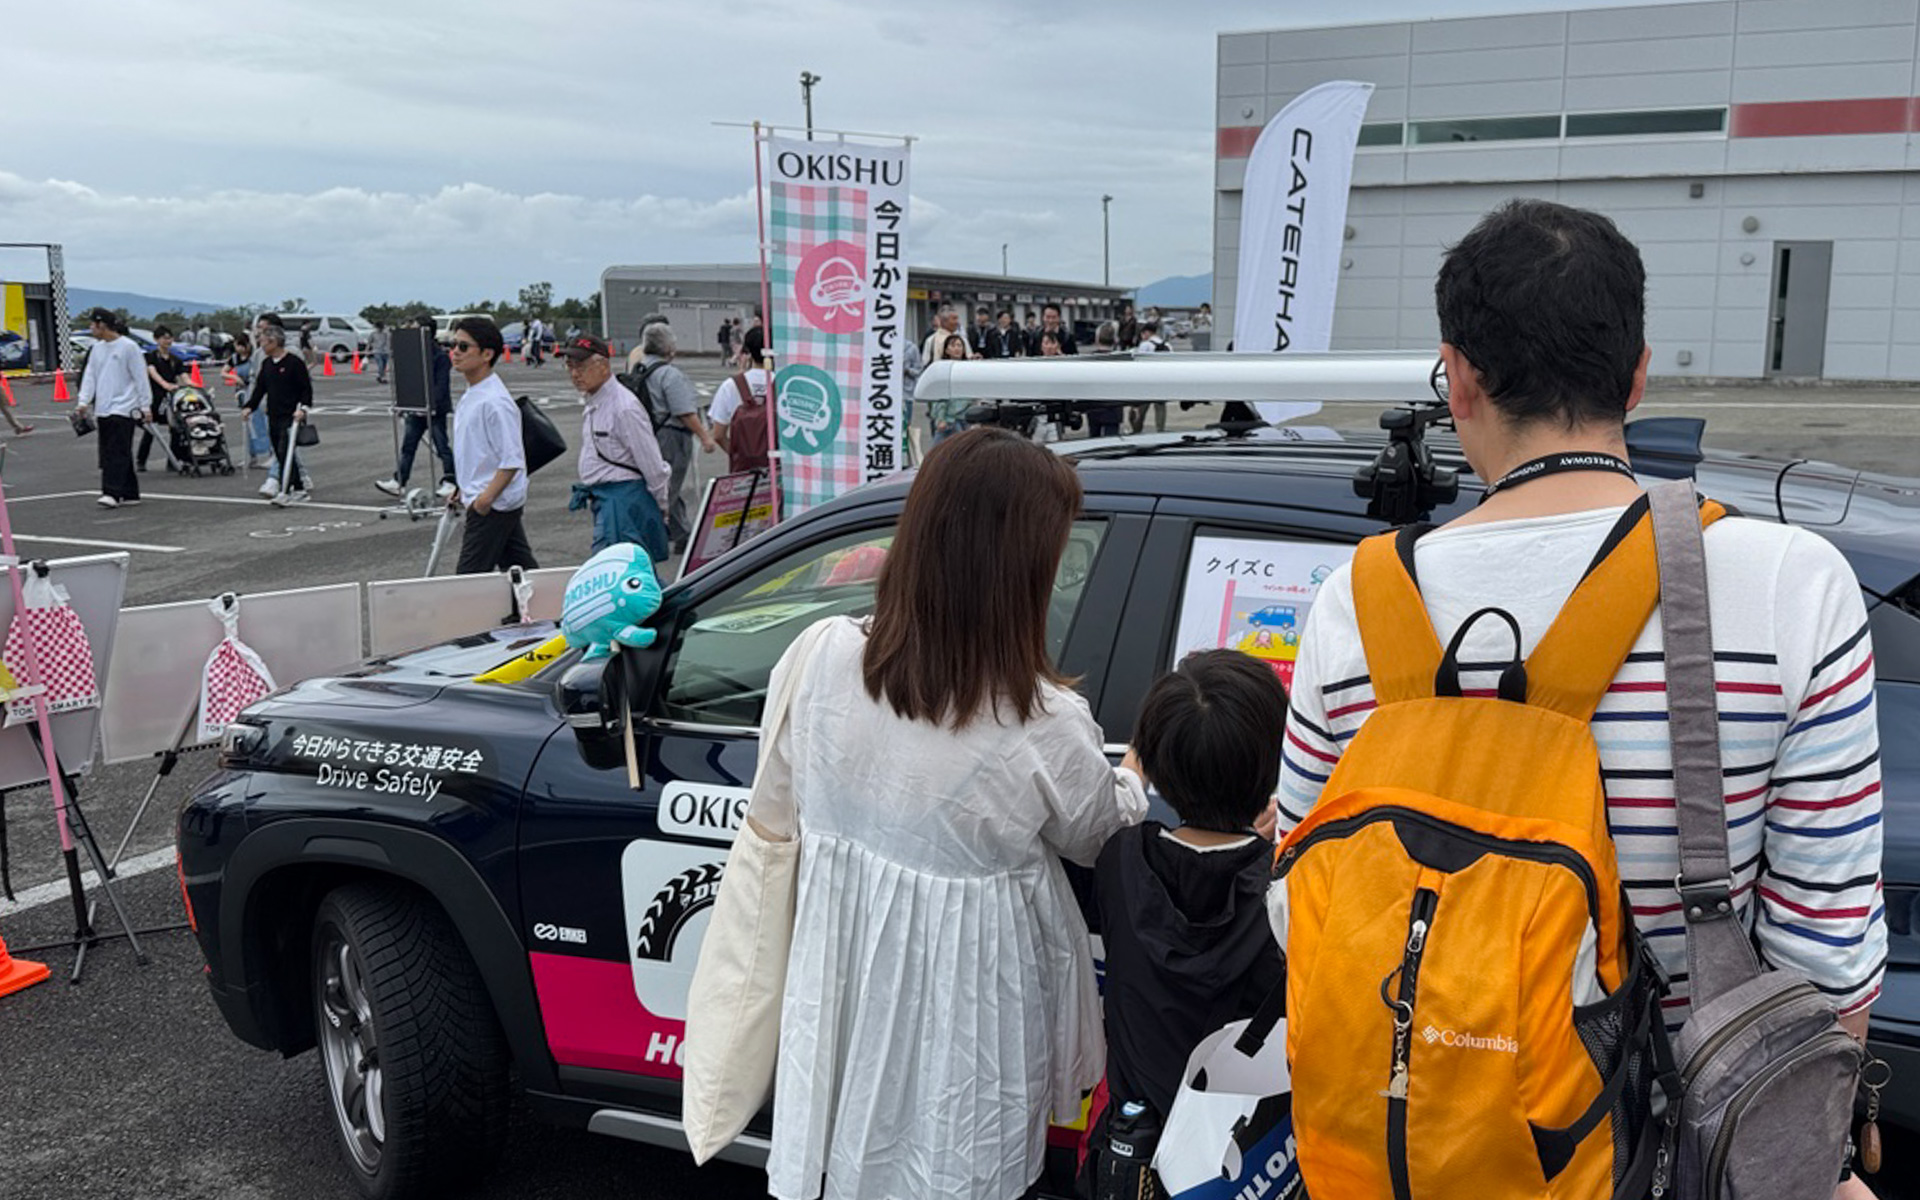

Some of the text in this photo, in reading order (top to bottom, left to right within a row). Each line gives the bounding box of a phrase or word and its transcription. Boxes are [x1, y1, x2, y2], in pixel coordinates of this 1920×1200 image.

[777, 151, 904, 187] OKISHU
[292, 733, 484, 773] 今日からできる交通安全
[317, 763, 442, 802] Drive Safely
[1441, 1029, 1519, 1053] Columbia
